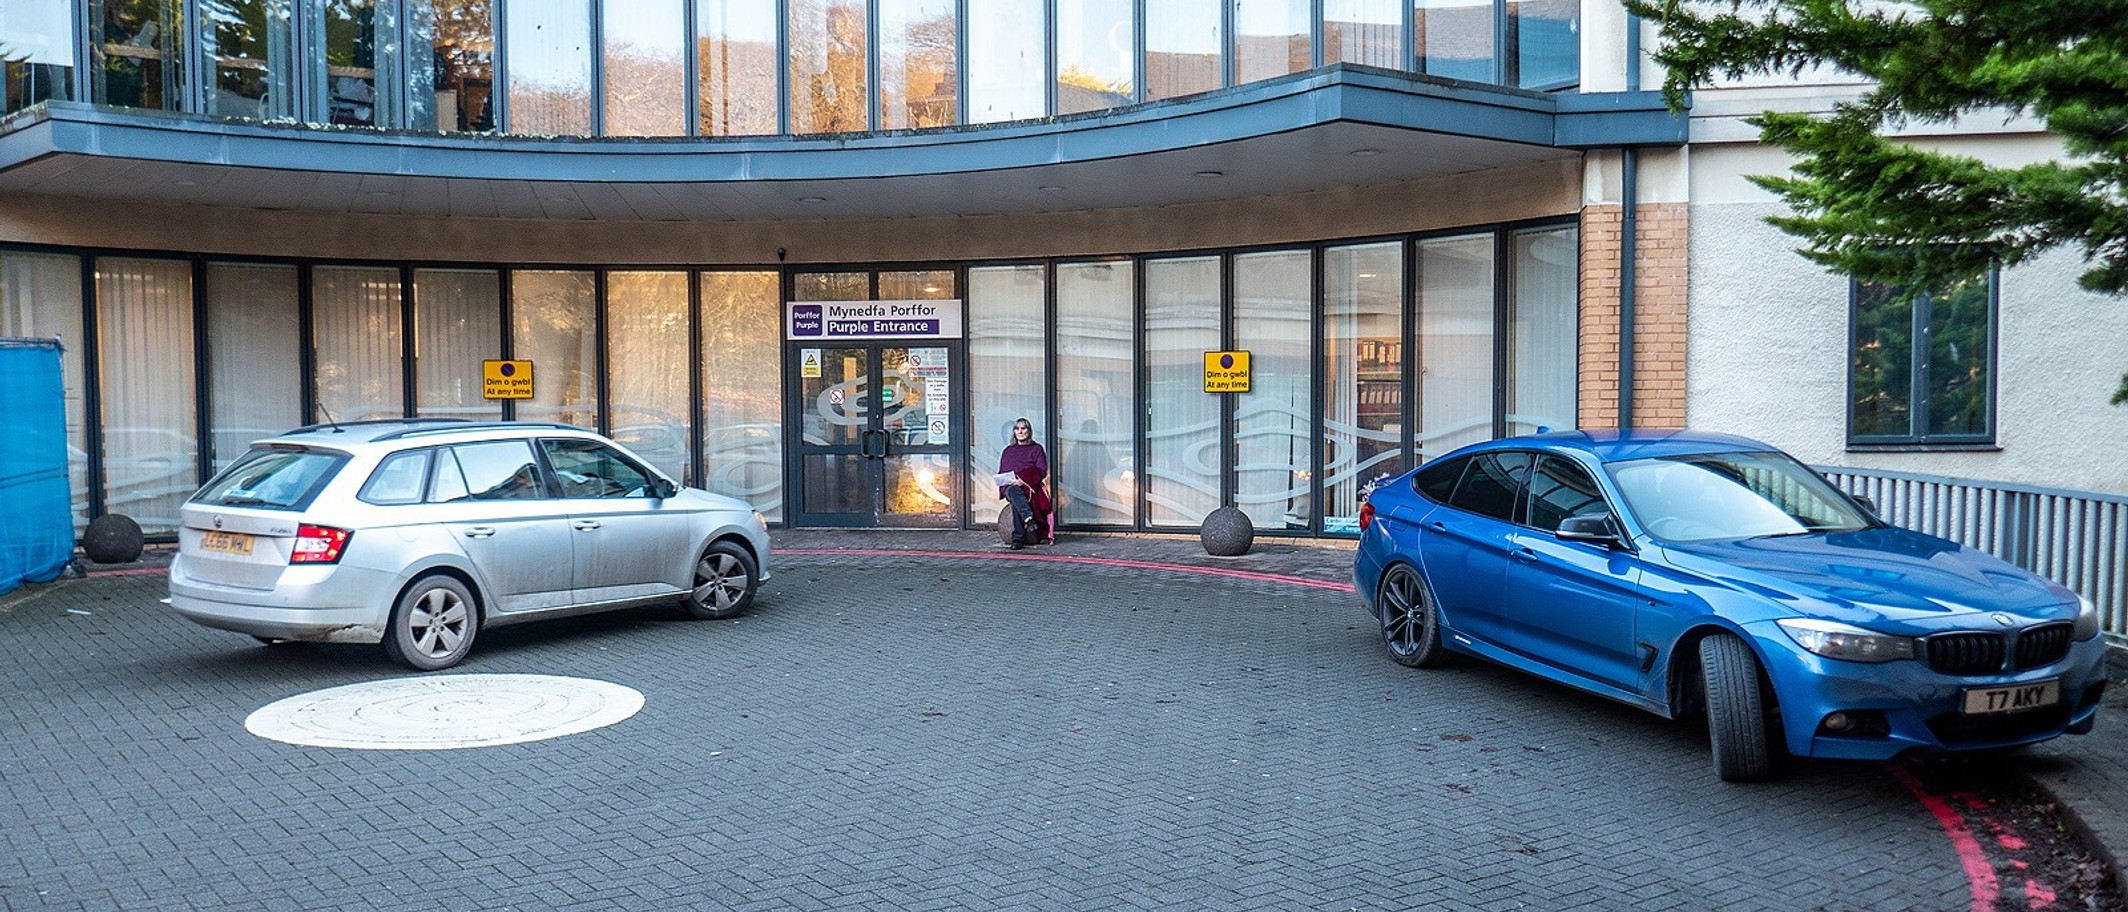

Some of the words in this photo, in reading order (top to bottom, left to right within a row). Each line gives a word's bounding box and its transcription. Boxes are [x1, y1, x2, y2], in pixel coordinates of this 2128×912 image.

[794, 311, 821, 320] Porffor
[829, 305, 886, 319] Mynedfa
[891, 304, 936, 317] Porffor
[796, 321, 819, 331] Purple
[829, 321, 869, 335] Purple
[873, 320, 929, 332] Entrance
[1207, 370, 1221, 378] Dim
[1216, 381, 1230, 389] any
[1231, 380, 1247, 388] time
[1986, 690, 2009, 710] T7
[2012, 686, 2045, 707] AKY
